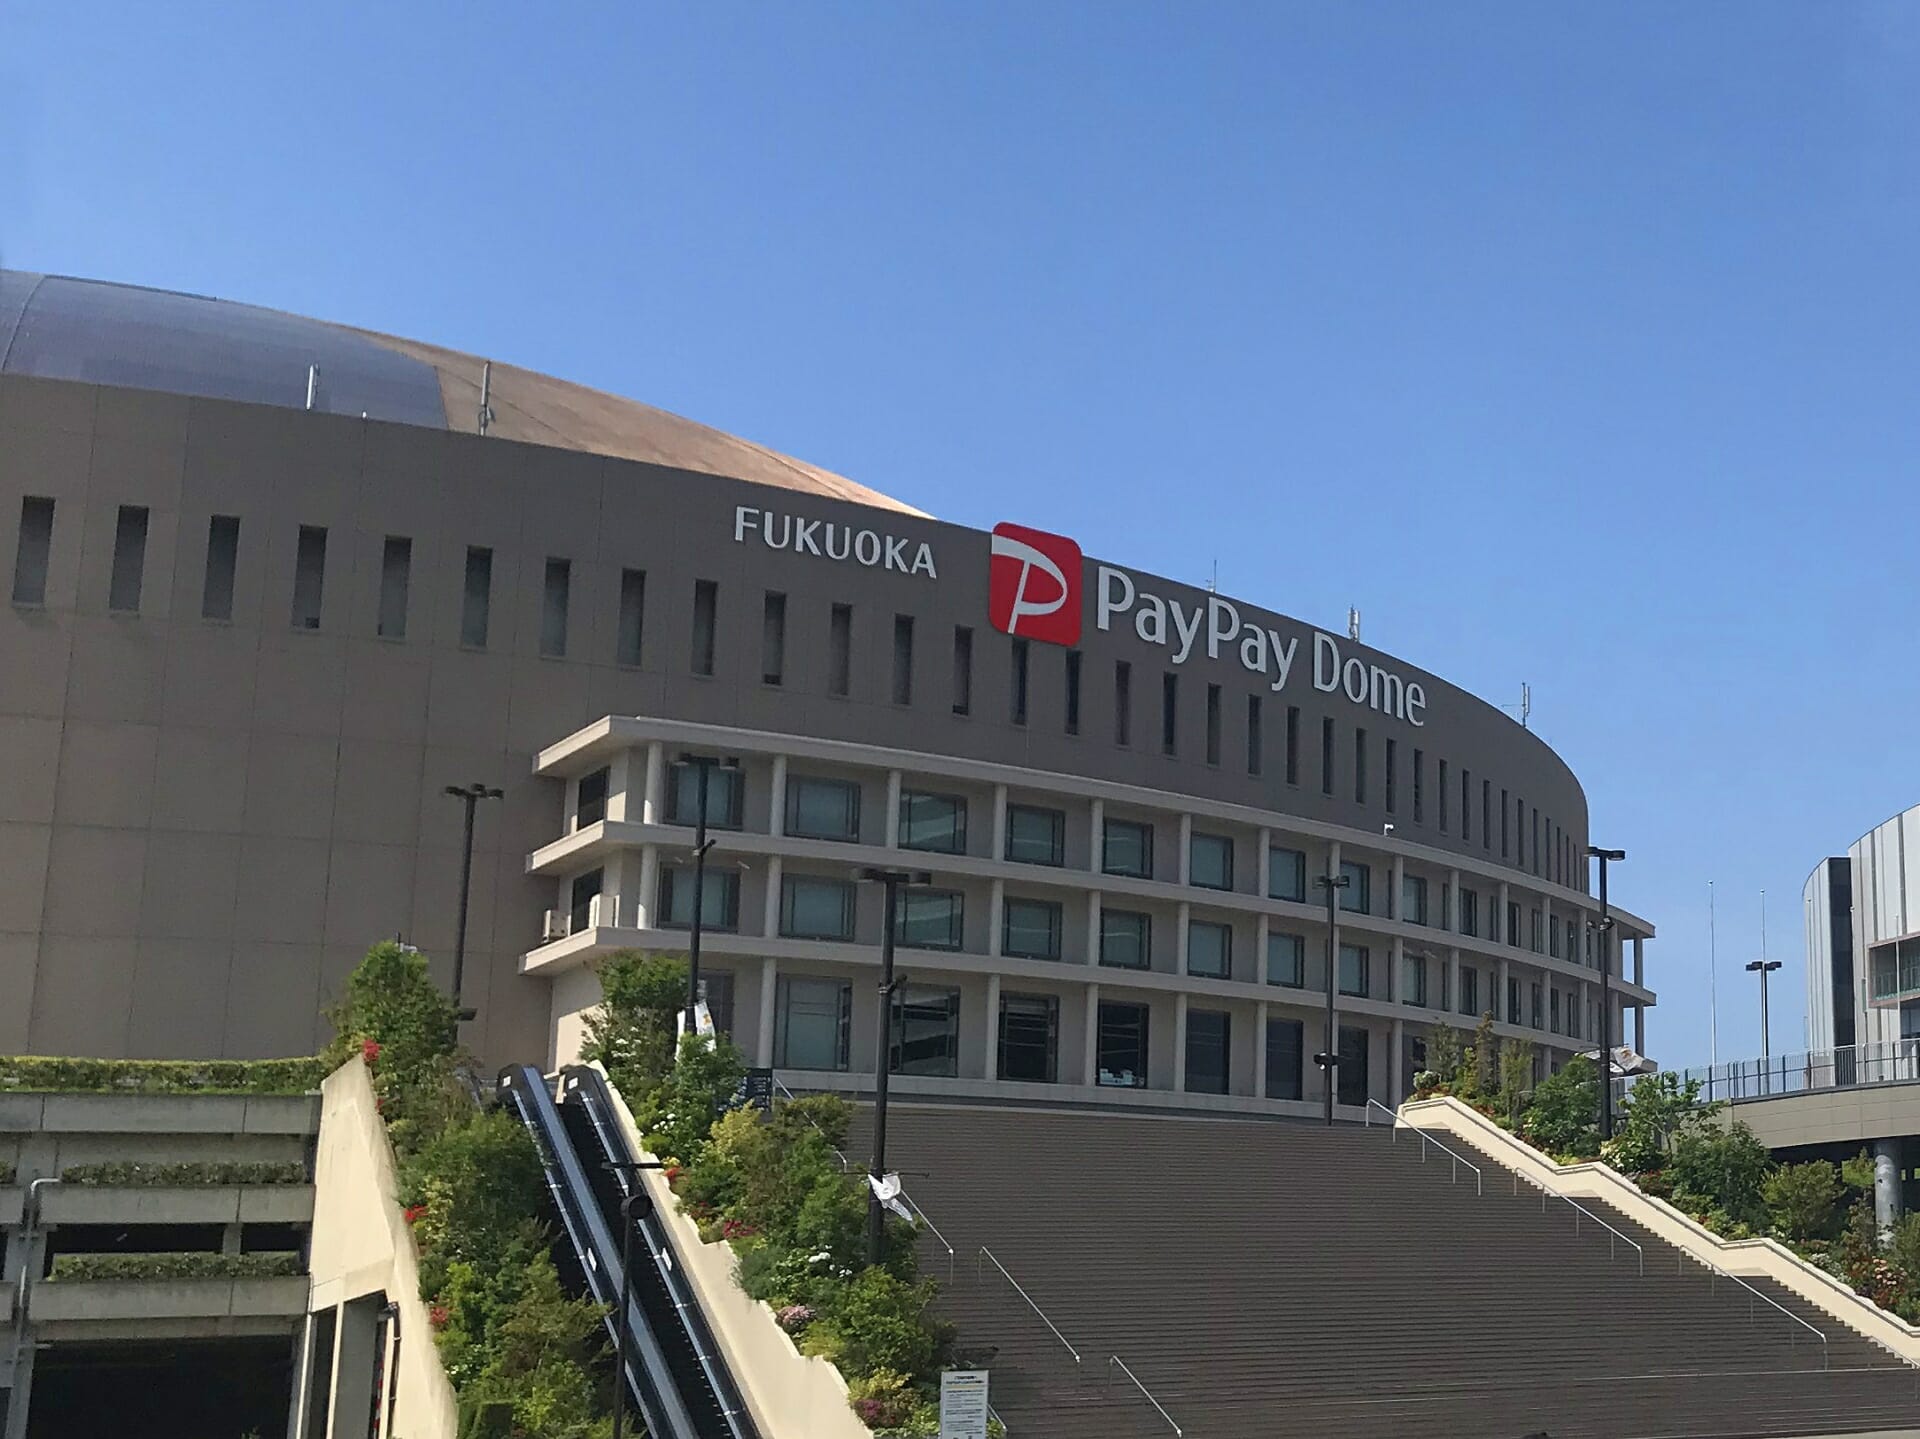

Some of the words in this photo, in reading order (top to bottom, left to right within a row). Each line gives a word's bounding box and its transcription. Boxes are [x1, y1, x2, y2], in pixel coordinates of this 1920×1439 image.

[734, 506, 936, 578] FUKUOKA
[1097, 567, 1298, 690] PayPay
[1313, 632, 1426, 726] Dome
